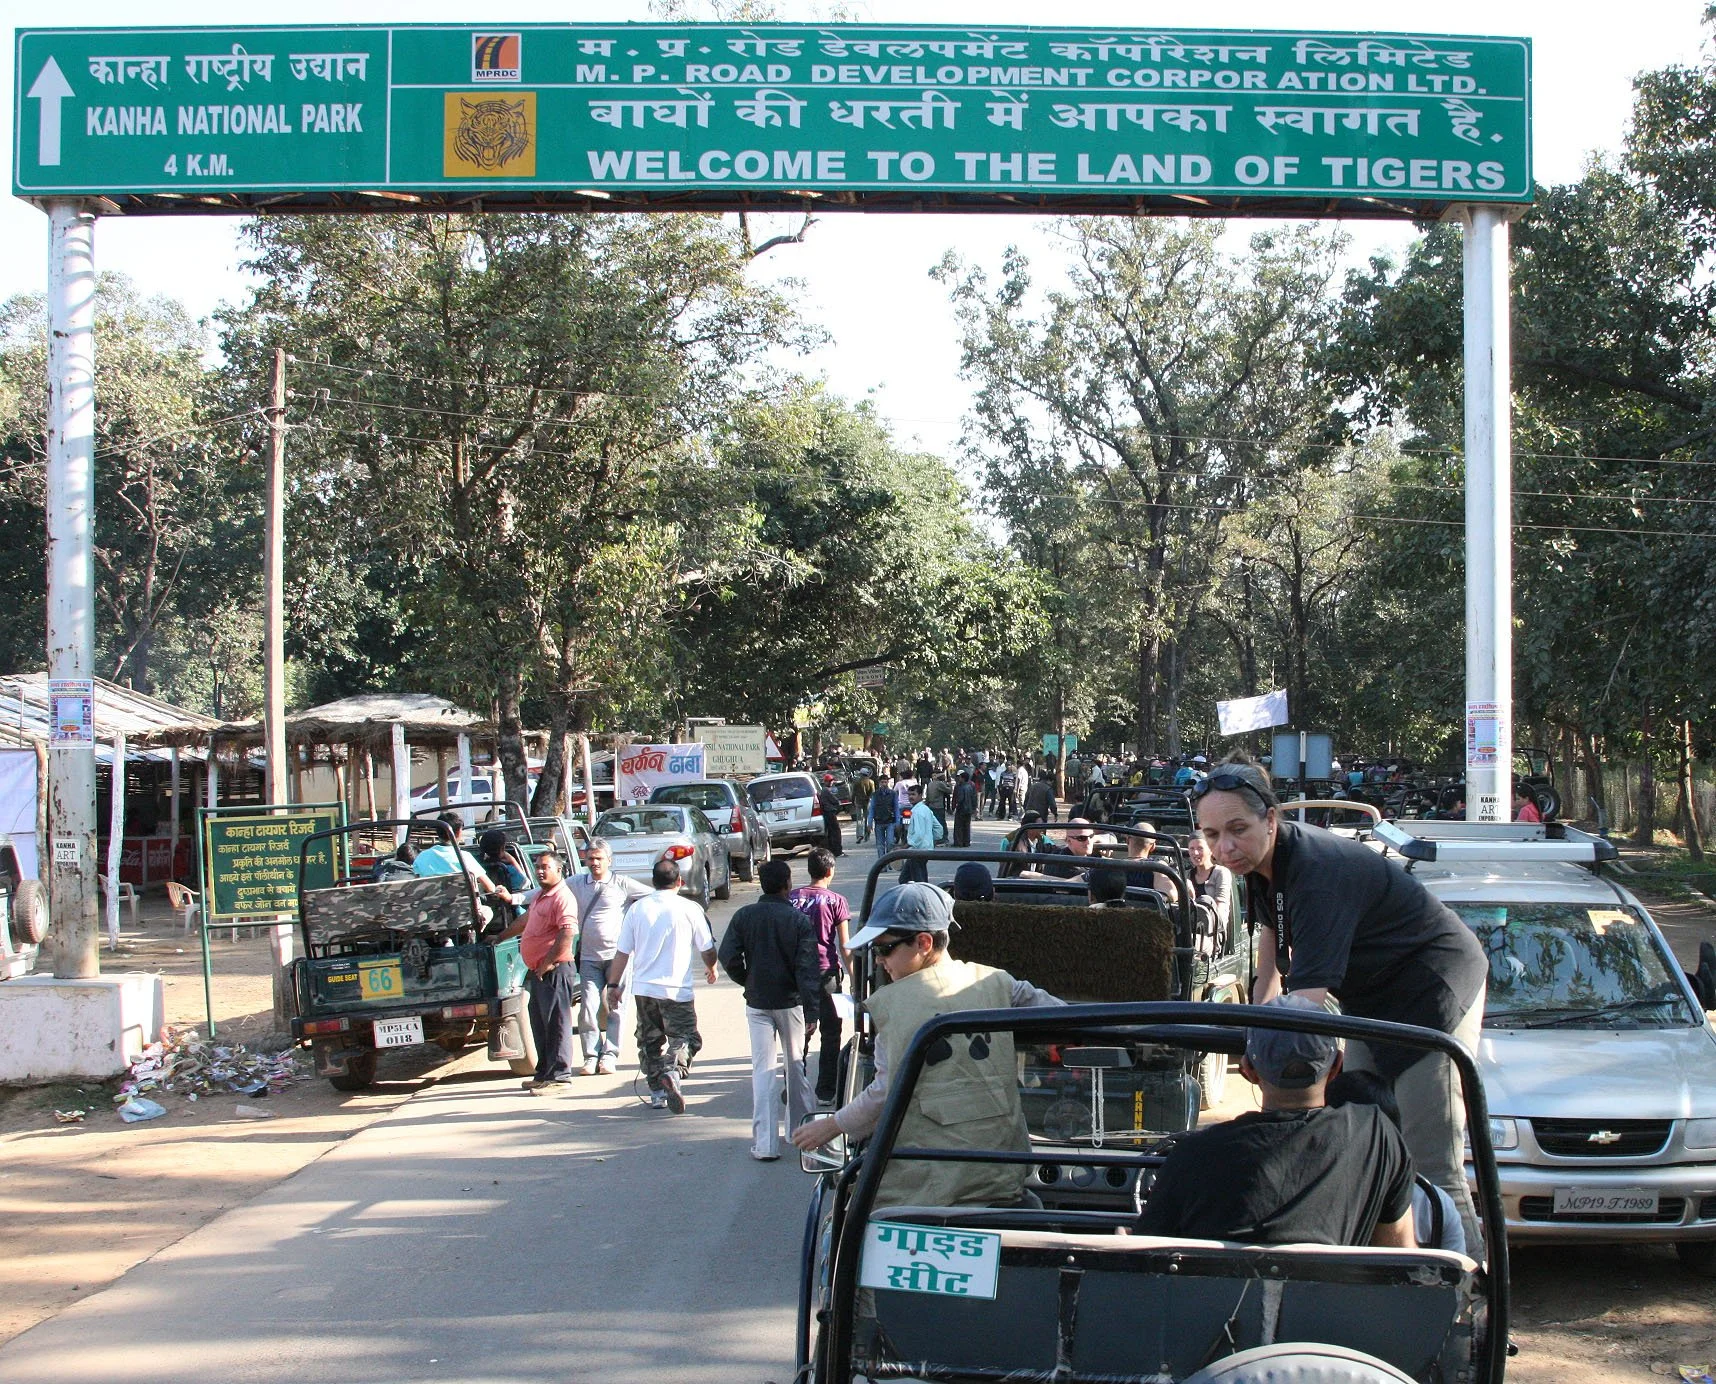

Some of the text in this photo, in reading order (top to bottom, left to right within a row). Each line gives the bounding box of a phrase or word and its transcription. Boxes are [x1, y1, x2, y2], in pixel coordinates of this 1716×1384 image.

[726, 30, 805, 57] रोड
[819, 30, 1028, 60] डेवलपमेंट
[1291, 39, 1474, 68] लिमिटेड
[88, 43, 370, 92] कान्हा राष्ट्रीय उद्यान
[685, 64, 792, 83] ROAD
[811, 64, 1094, 86] DEVELOPMENT
[1407, 74, 1487, 95] LTD.
[87, 103, 363, 136] KANHA NATIONAL PARK
[588, 88, 716, 129] बाघों
[734, 88, 808, 129] की
[829, 90, 962, 130] धरती
[986, 90, 1029, 131] में
[1049, 104, 1233, 133] आपका
[1254, 105, 1420, 137] स्वागत
[163, 154, 234, 176] 4 K.M.
[587, 150, 1506, 191] WELCOME TO THE LAND OF TIGERS
[719, 743, 744, 751] NATIONAL
[745, 743, 760, 751] PARK
[669, 755, 701, 774] ढाबा
[226, 820, 316, 838] कान्हा टायगर रिजर्व
[57, 851, 75, 860] ART
[218, 839, 290, 854] कान्हा टायगर रिजर्व
[285, 868, 294, 879] के
[266, 884, 275, 894] से
[1276, 892, 1284, 912] EOS
[328, 973, 358, 983] GUIDE SEAT
[369, 967, 392, 992] 66
[877, 1226, 989, 1260] गाइड
[887, 1261, 974, 1294] सीट
